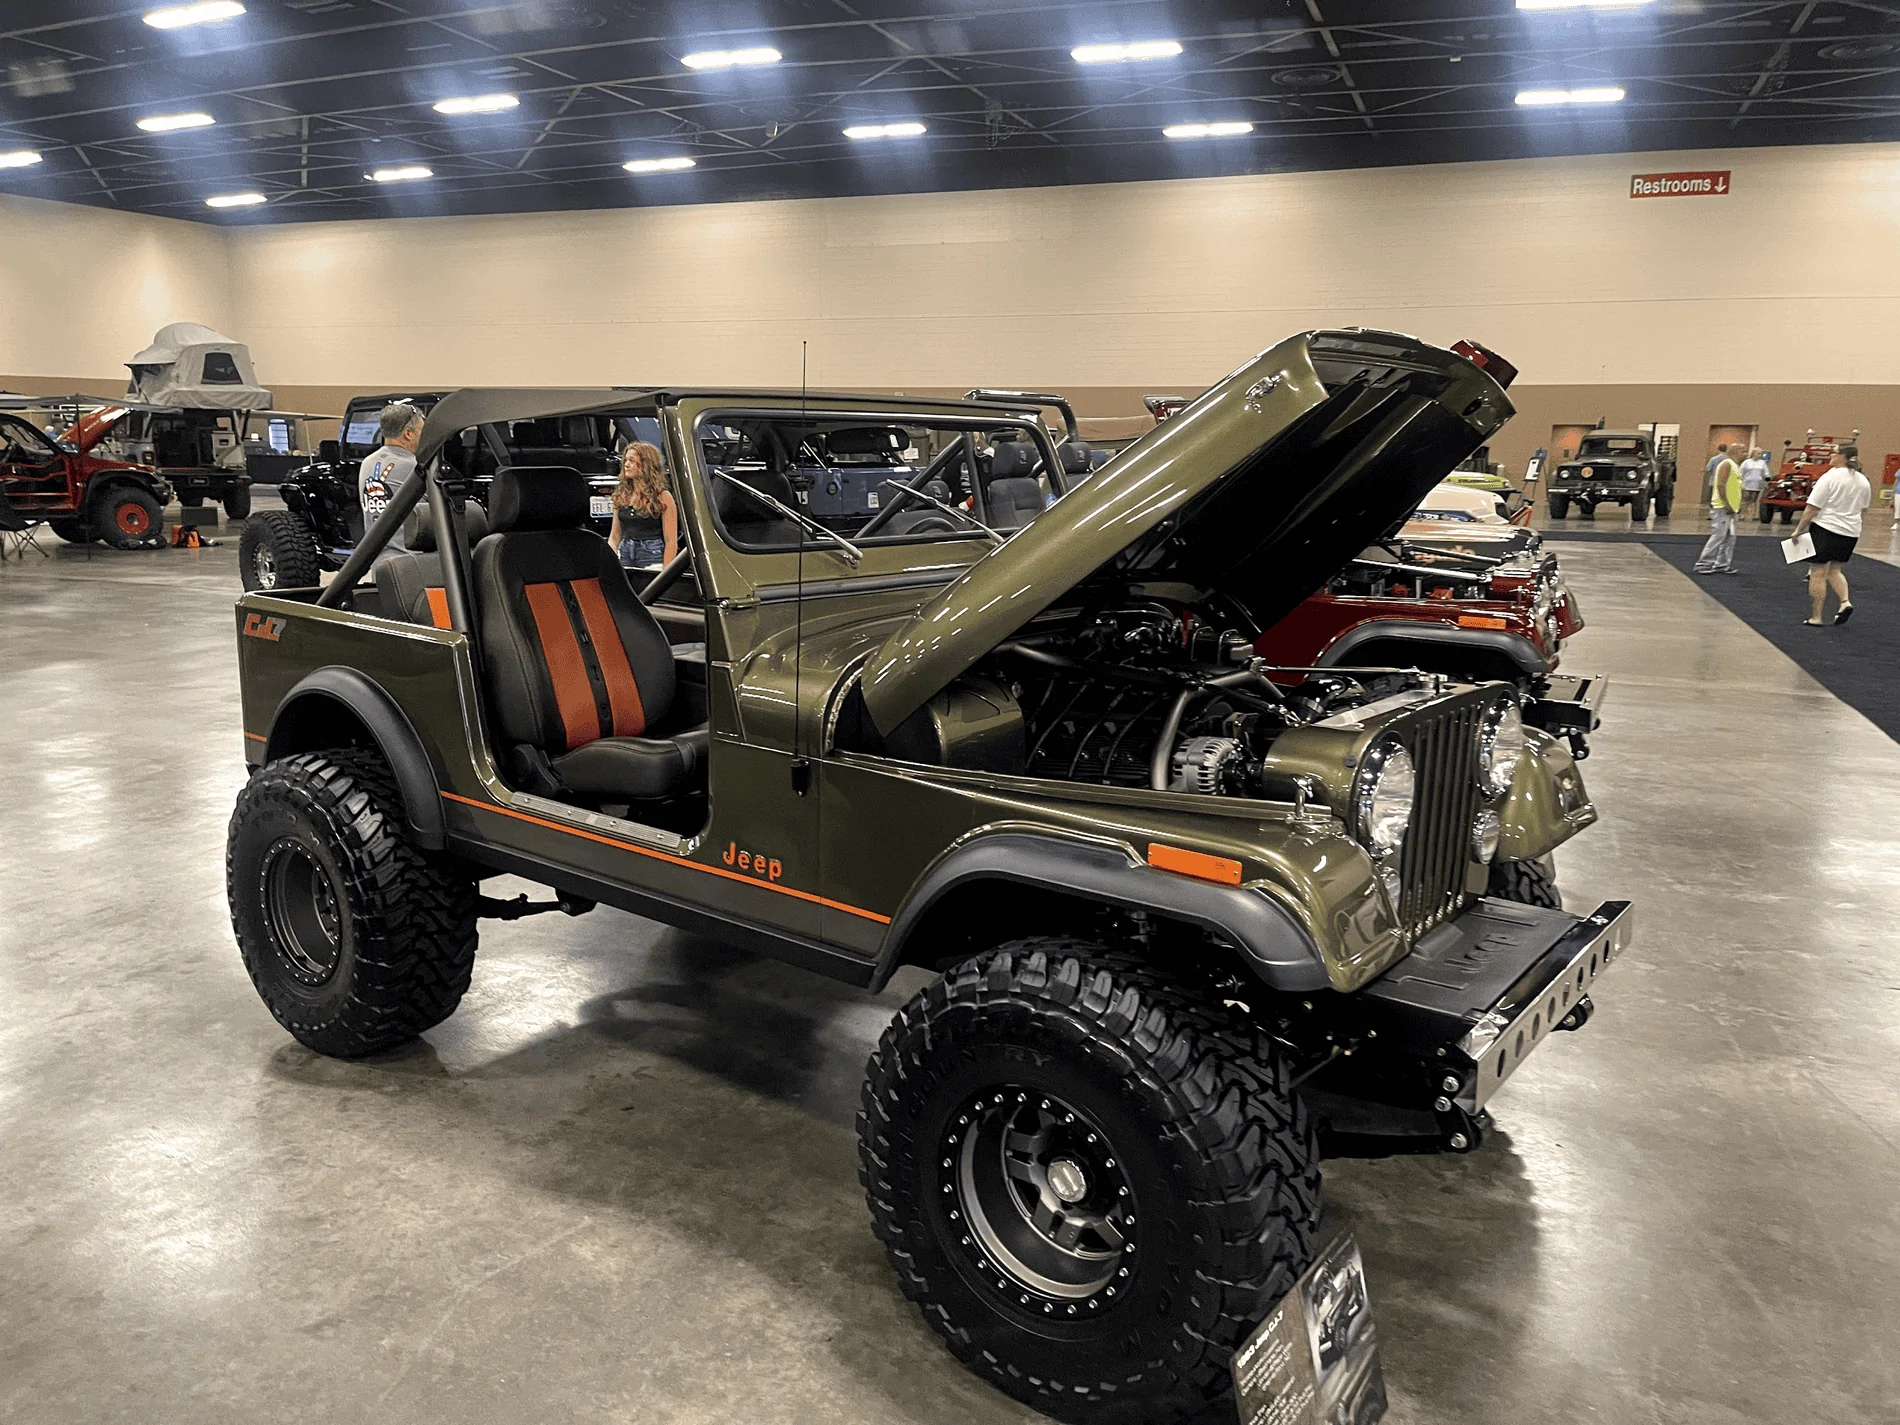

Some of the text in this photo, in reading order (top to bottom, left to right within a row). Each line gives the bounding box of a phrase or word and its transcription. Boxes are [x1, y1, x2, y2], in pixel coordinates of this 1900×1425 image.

[1632, 177, 1712, 195] Restrooms
[722, 841, 783, 882] Jeep
[1255, 1330, 1270, 1350] Jeep
